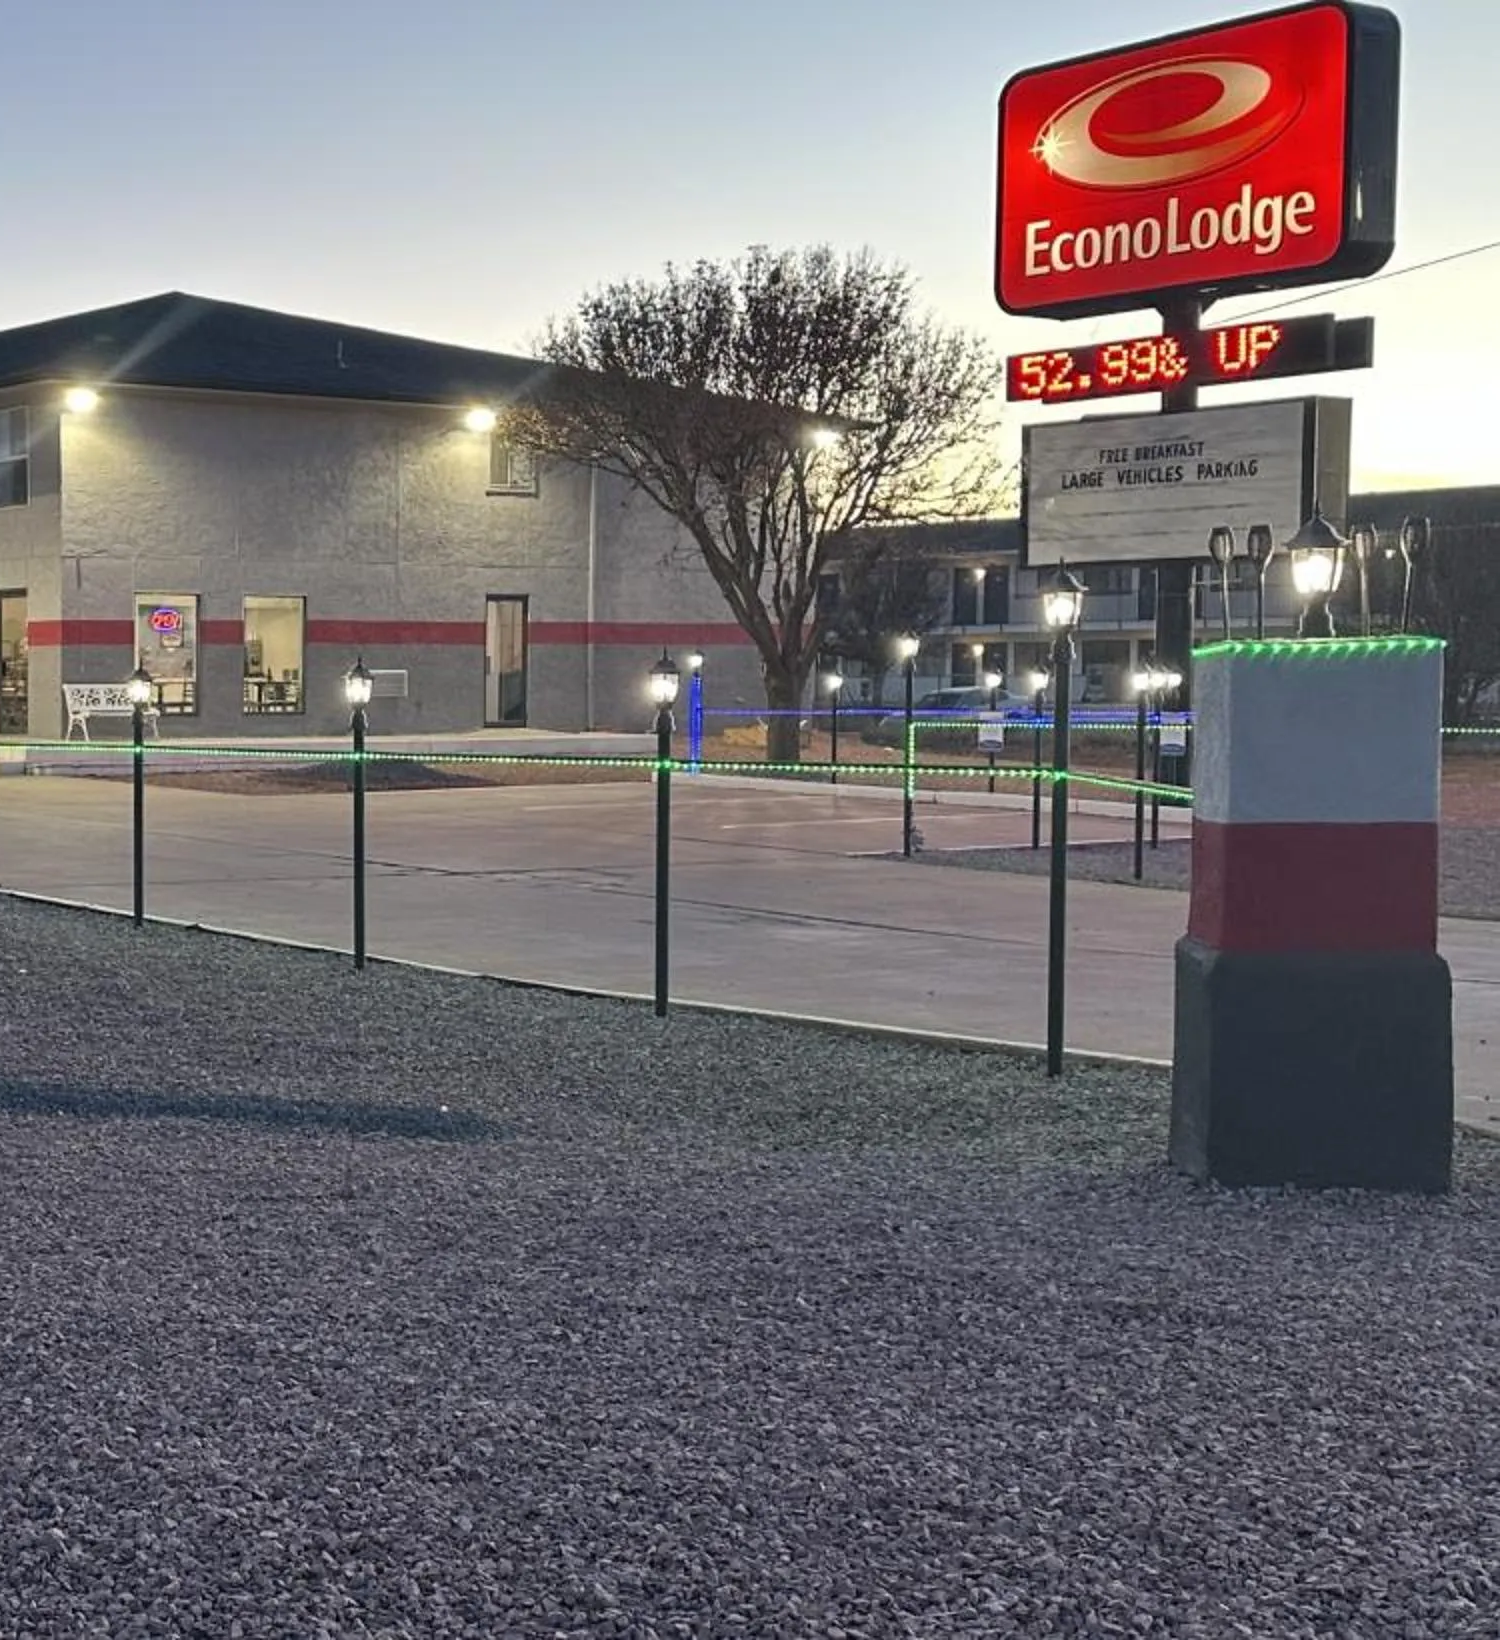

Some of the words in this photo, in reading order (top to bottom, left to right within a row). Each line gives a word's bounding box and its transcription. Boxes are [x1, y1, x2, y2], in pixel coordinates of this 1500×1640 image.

[1217, 324, 1282, 370] UP
[1099, 447, 1129, 465] FREE
[1134, 441, 1205, 461] BREAKFAST
[1061, 471, 1105, 490] LARGE
[1117, 465, 1185, 486] VEHICLES
[1197, 459, 1259, 481] PARKING
